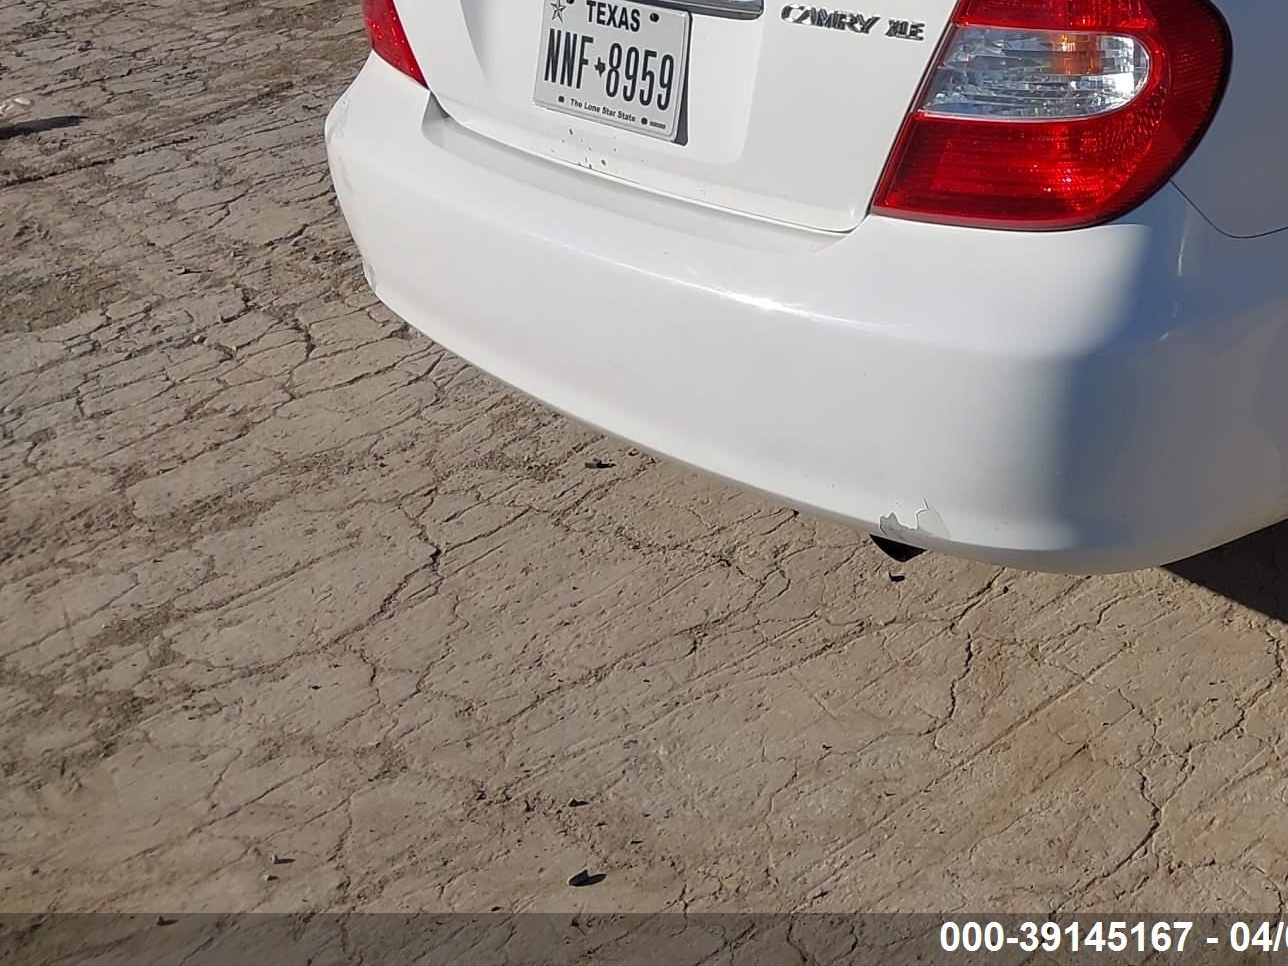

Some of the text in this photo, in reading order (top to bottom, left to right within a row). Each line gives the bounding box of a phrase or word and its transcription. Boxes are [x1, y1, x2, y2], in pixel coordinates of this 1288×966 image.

[586, 0, 641, 33] TEXAS
[781, 2, 881, 35] CAMRY
[605, 42, 675, 111] 8959
[570, 98, 636, 122] The Lone Star State
